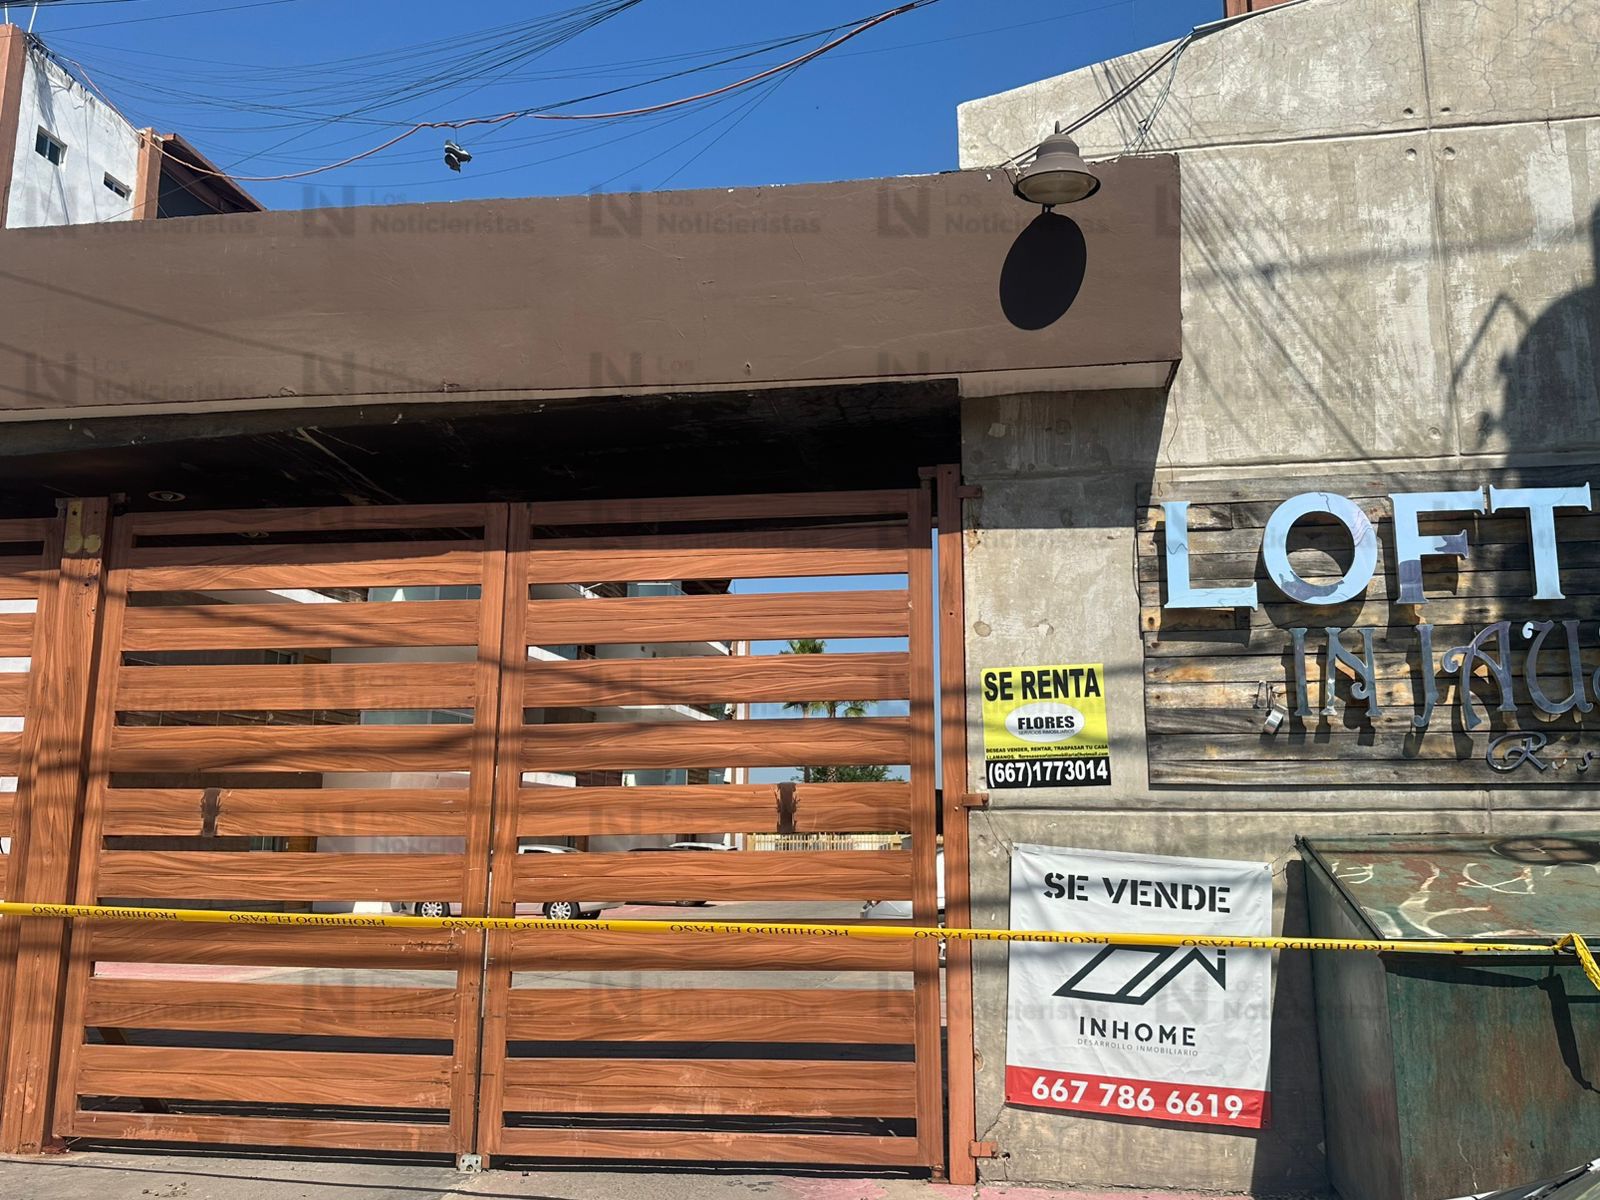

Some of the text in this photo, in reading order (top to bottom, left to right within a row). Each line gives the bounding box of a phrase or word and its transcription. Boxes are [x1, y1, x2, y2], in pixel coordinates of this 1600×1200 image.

[1160, 481, 1592, 611] LOFT
[984, 668, 1101, 701] SE RENTA
[1288, 620, 1600, 730] IN JAU
[1017, 715, 1075, 730] FLORES
[988, 760, 1108, 788] (667)1773014
[1043, 872, 1231, 914] SE VENDE
[32, 906, 178, 920] PROHIBIDO EL PASO
[229, 914, 386, 927] PROHIBIDO EL PASO
[442, 919, 610, 931] PROHIBIDO EL PASO
[670, 924, 849, 937] PROHIBIDO EL PASO
[1079, 1016, 1196, 1047] INHOME
[1077, 1038, 1199, 1057] DESARROLLO INMOBILIARIO
[1031, 1076, 1243, 1119] 667 786 6619
